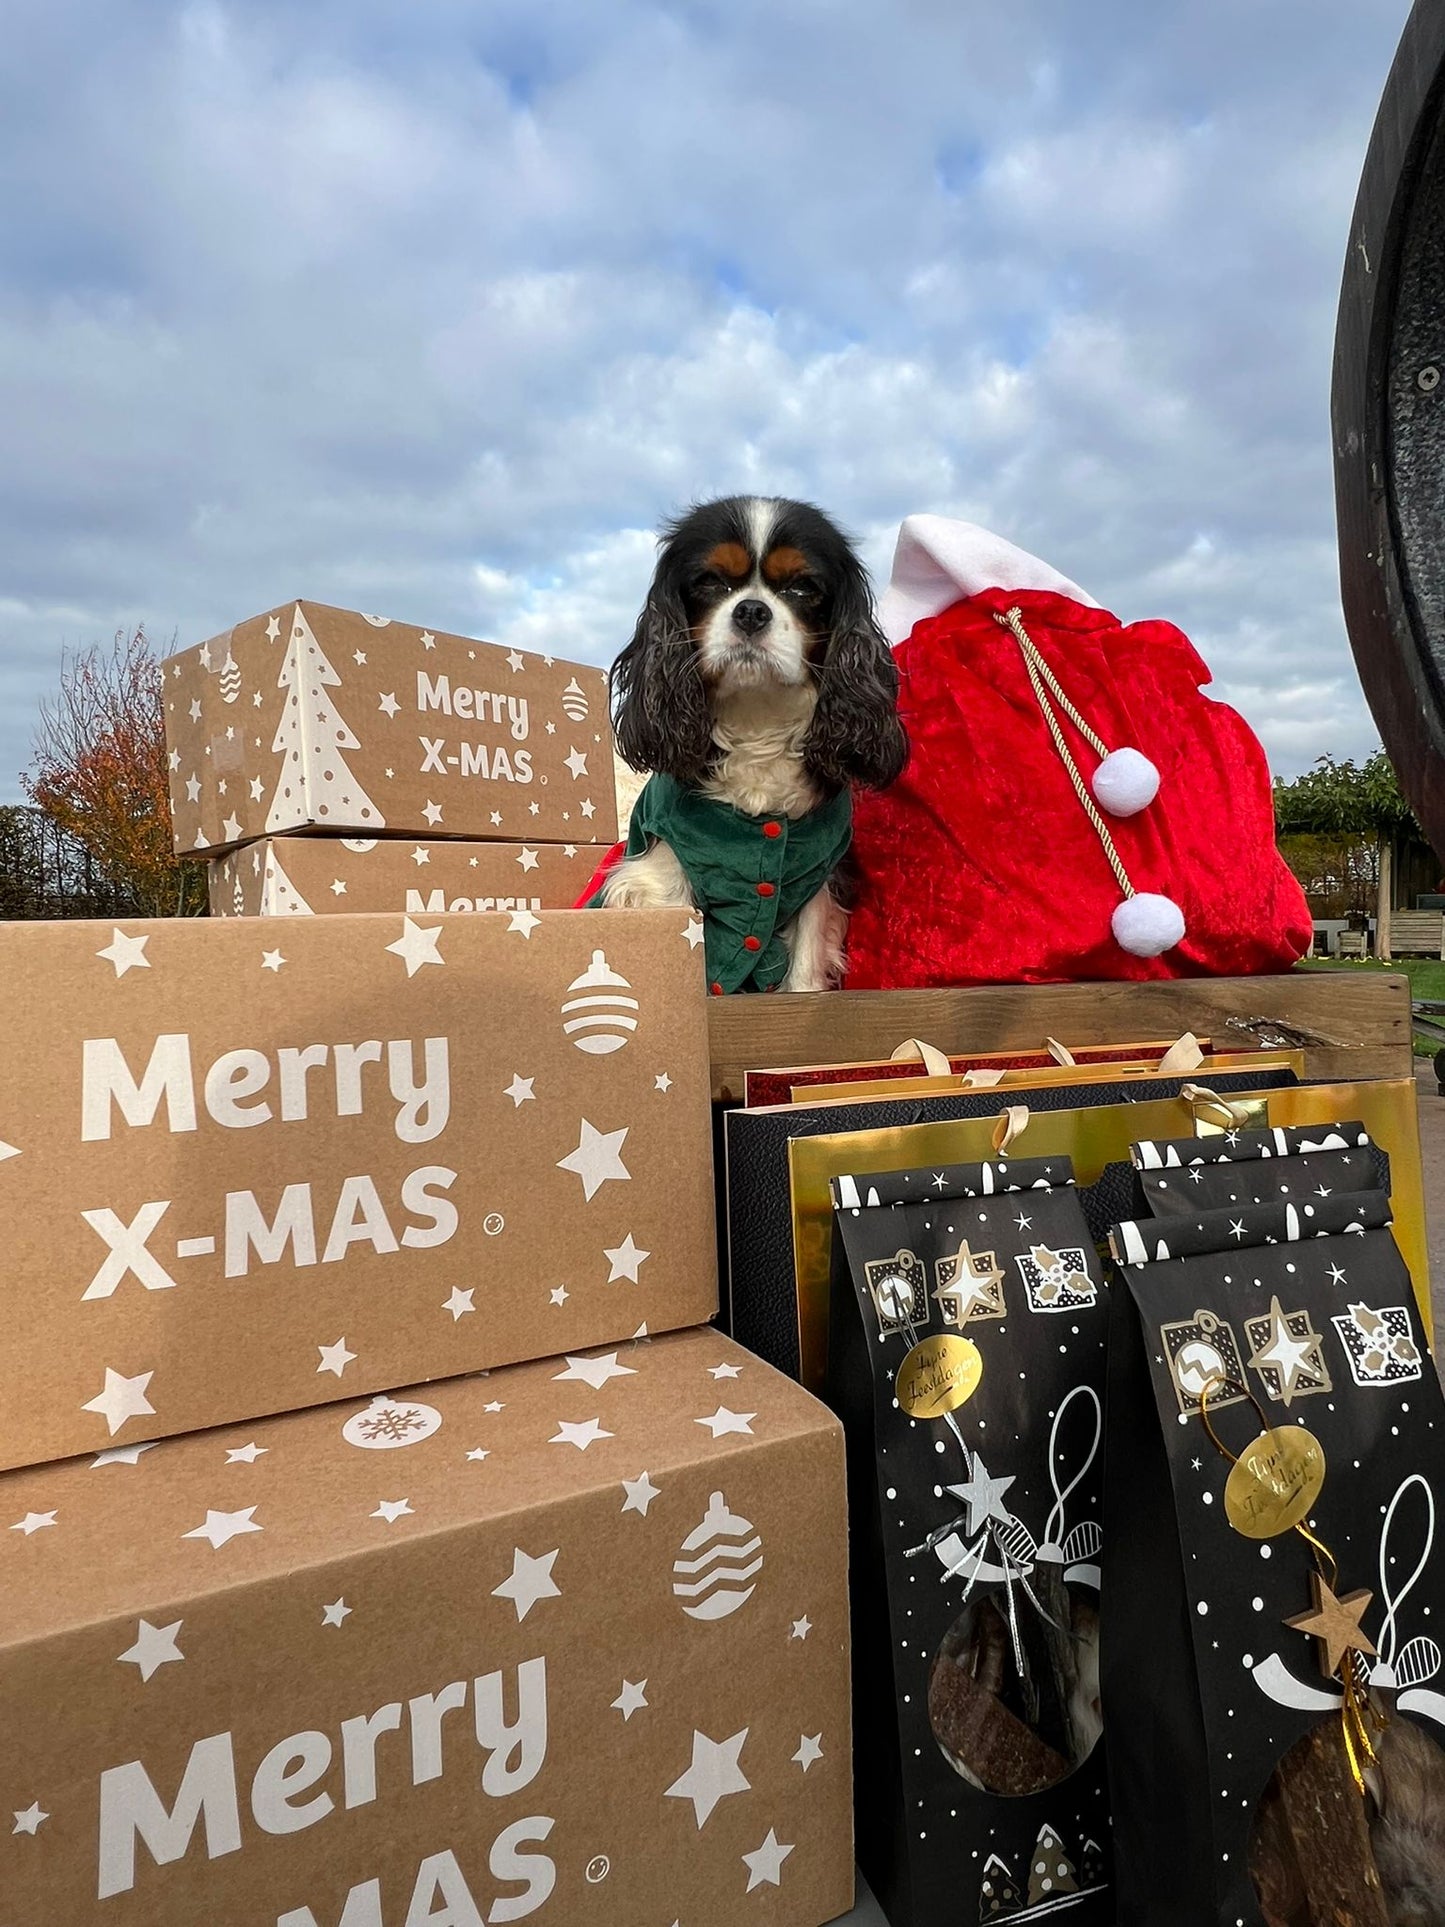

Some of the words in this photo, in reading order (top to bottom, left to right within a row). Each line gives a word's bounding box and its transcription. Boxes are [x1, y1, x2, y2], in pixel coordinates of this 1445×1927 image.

[417, 670, 529, 741] Merry
[418, 736, 534, 784] X-MAS
[80, 1034, 451, 1144] Merry
[80, 1166, 459, 1301] X-MAS
[98, 1656, 548, 1900] Merry
